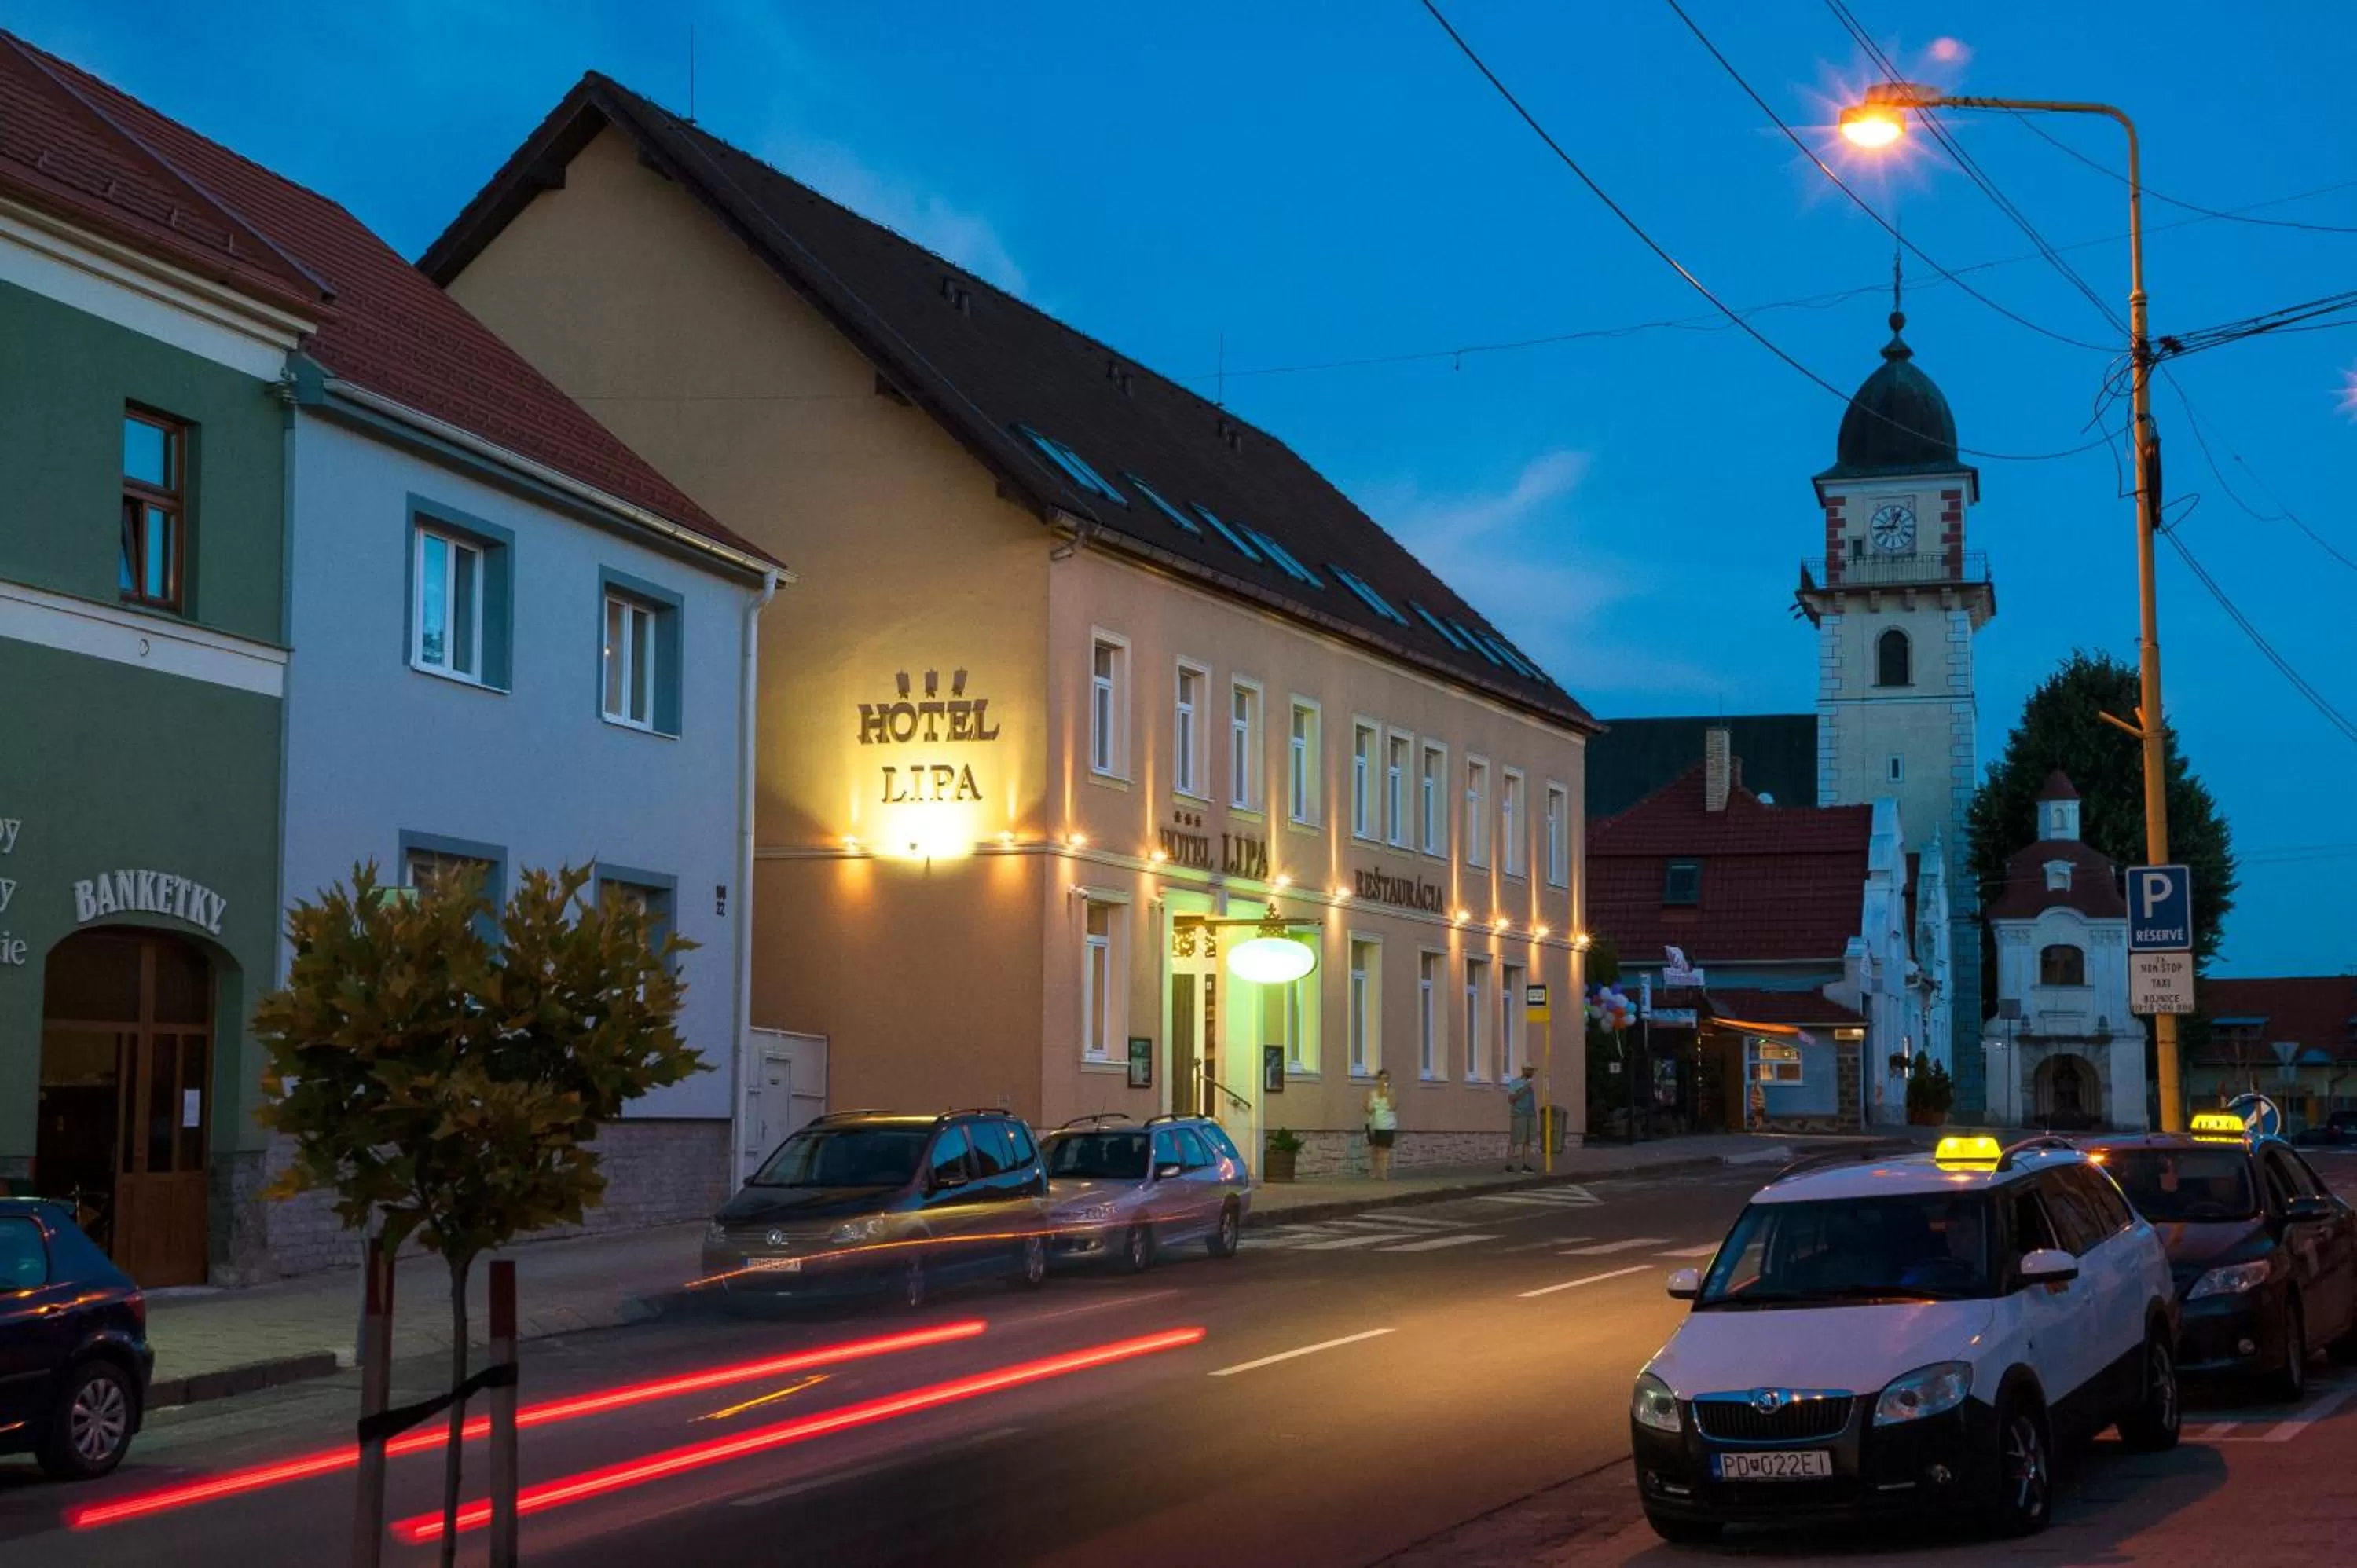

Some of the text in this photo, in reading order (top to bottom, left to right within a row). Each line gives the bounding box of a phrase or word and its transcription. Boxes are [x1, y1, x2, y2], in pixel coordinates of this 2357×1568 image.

[857, 698, 1000, 745] HOTEL
[881, 763, 983, 804] LIPA
[1159, 827, 1269, 879] HOTEL LIPA
[74, 870, 226, 936] BANKETKY
[2143, 873, 2172, 918] P
[2150, 978, 2171, 987] TAXI
